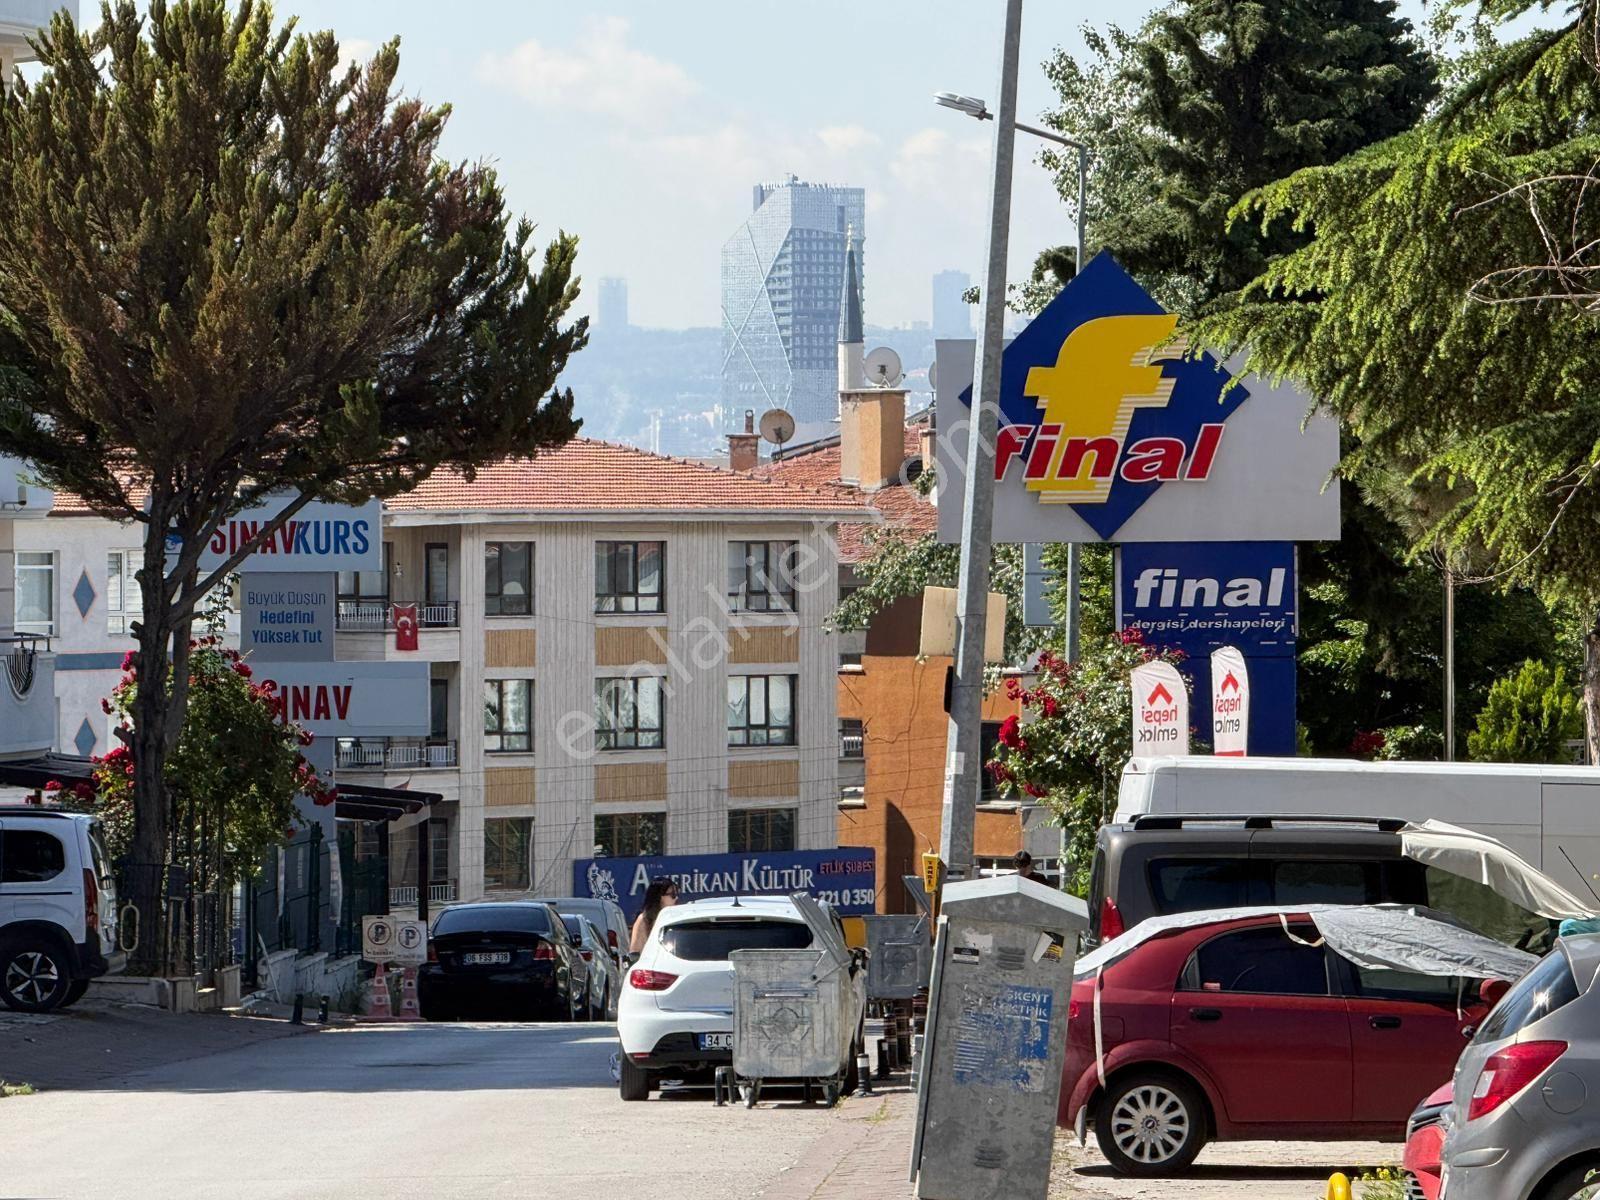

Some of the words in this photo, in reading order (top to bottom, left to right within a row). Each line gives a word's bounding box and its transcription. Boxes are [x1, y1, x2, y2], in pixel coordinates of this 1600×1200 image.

[994, 423, 1226, 482] final
[1133, 567, 1286, 607] final
[248, 592, 285, 606] Büyük
[260, 610, 314, 624] Hedefini
[1131, 619, 1185, 631] dergisi
[252, 629, 299, 644] Yüksek
[301, 629, 322, 643] Tut
[629, 863, 738, 896] AERİKAN
[742, 859, 815, 891] KÜLTÜR
[851, 888, 875, 905] 350
[707, 1035, 719, 1046] 34
